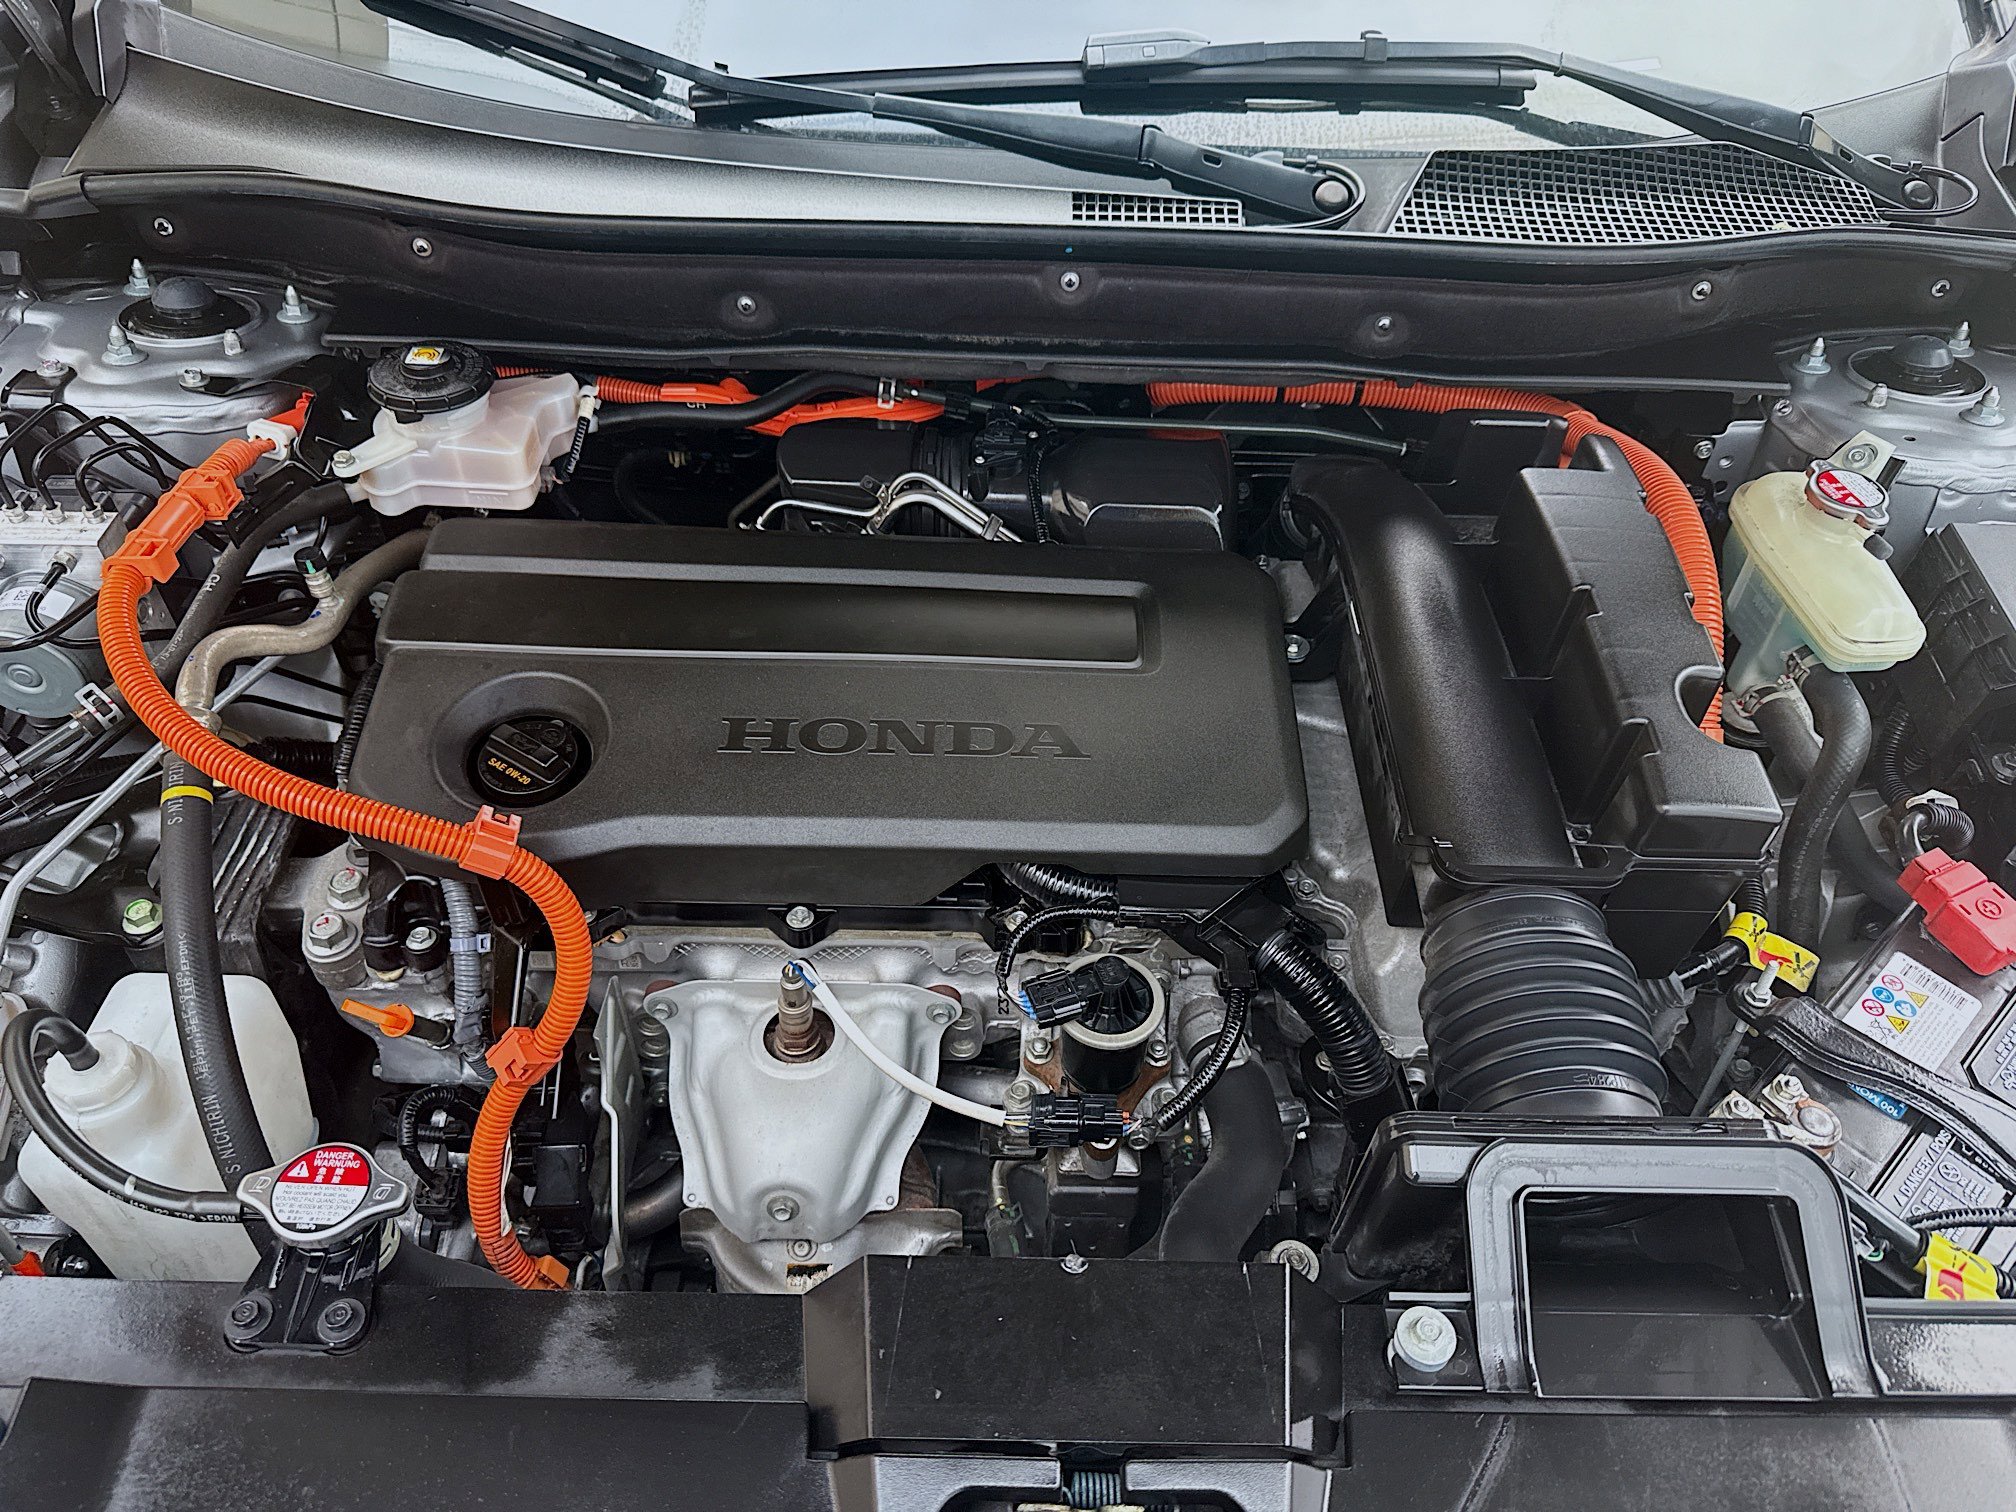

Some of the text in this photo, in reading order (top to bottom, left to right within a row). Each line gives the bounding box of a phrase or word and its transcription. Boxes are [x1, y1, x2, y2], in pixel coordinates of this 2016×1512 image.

[717, 717, 1091, 760] HONDA
[488, 757, 506, 772] SAE
[506, 767, 532, 785] 0W-20
[1880, 1101, 1899, 1117] 100
[315, 1150, 355, 1160] DANGER
[313, 1158, 361, 1169] WARNUNG
